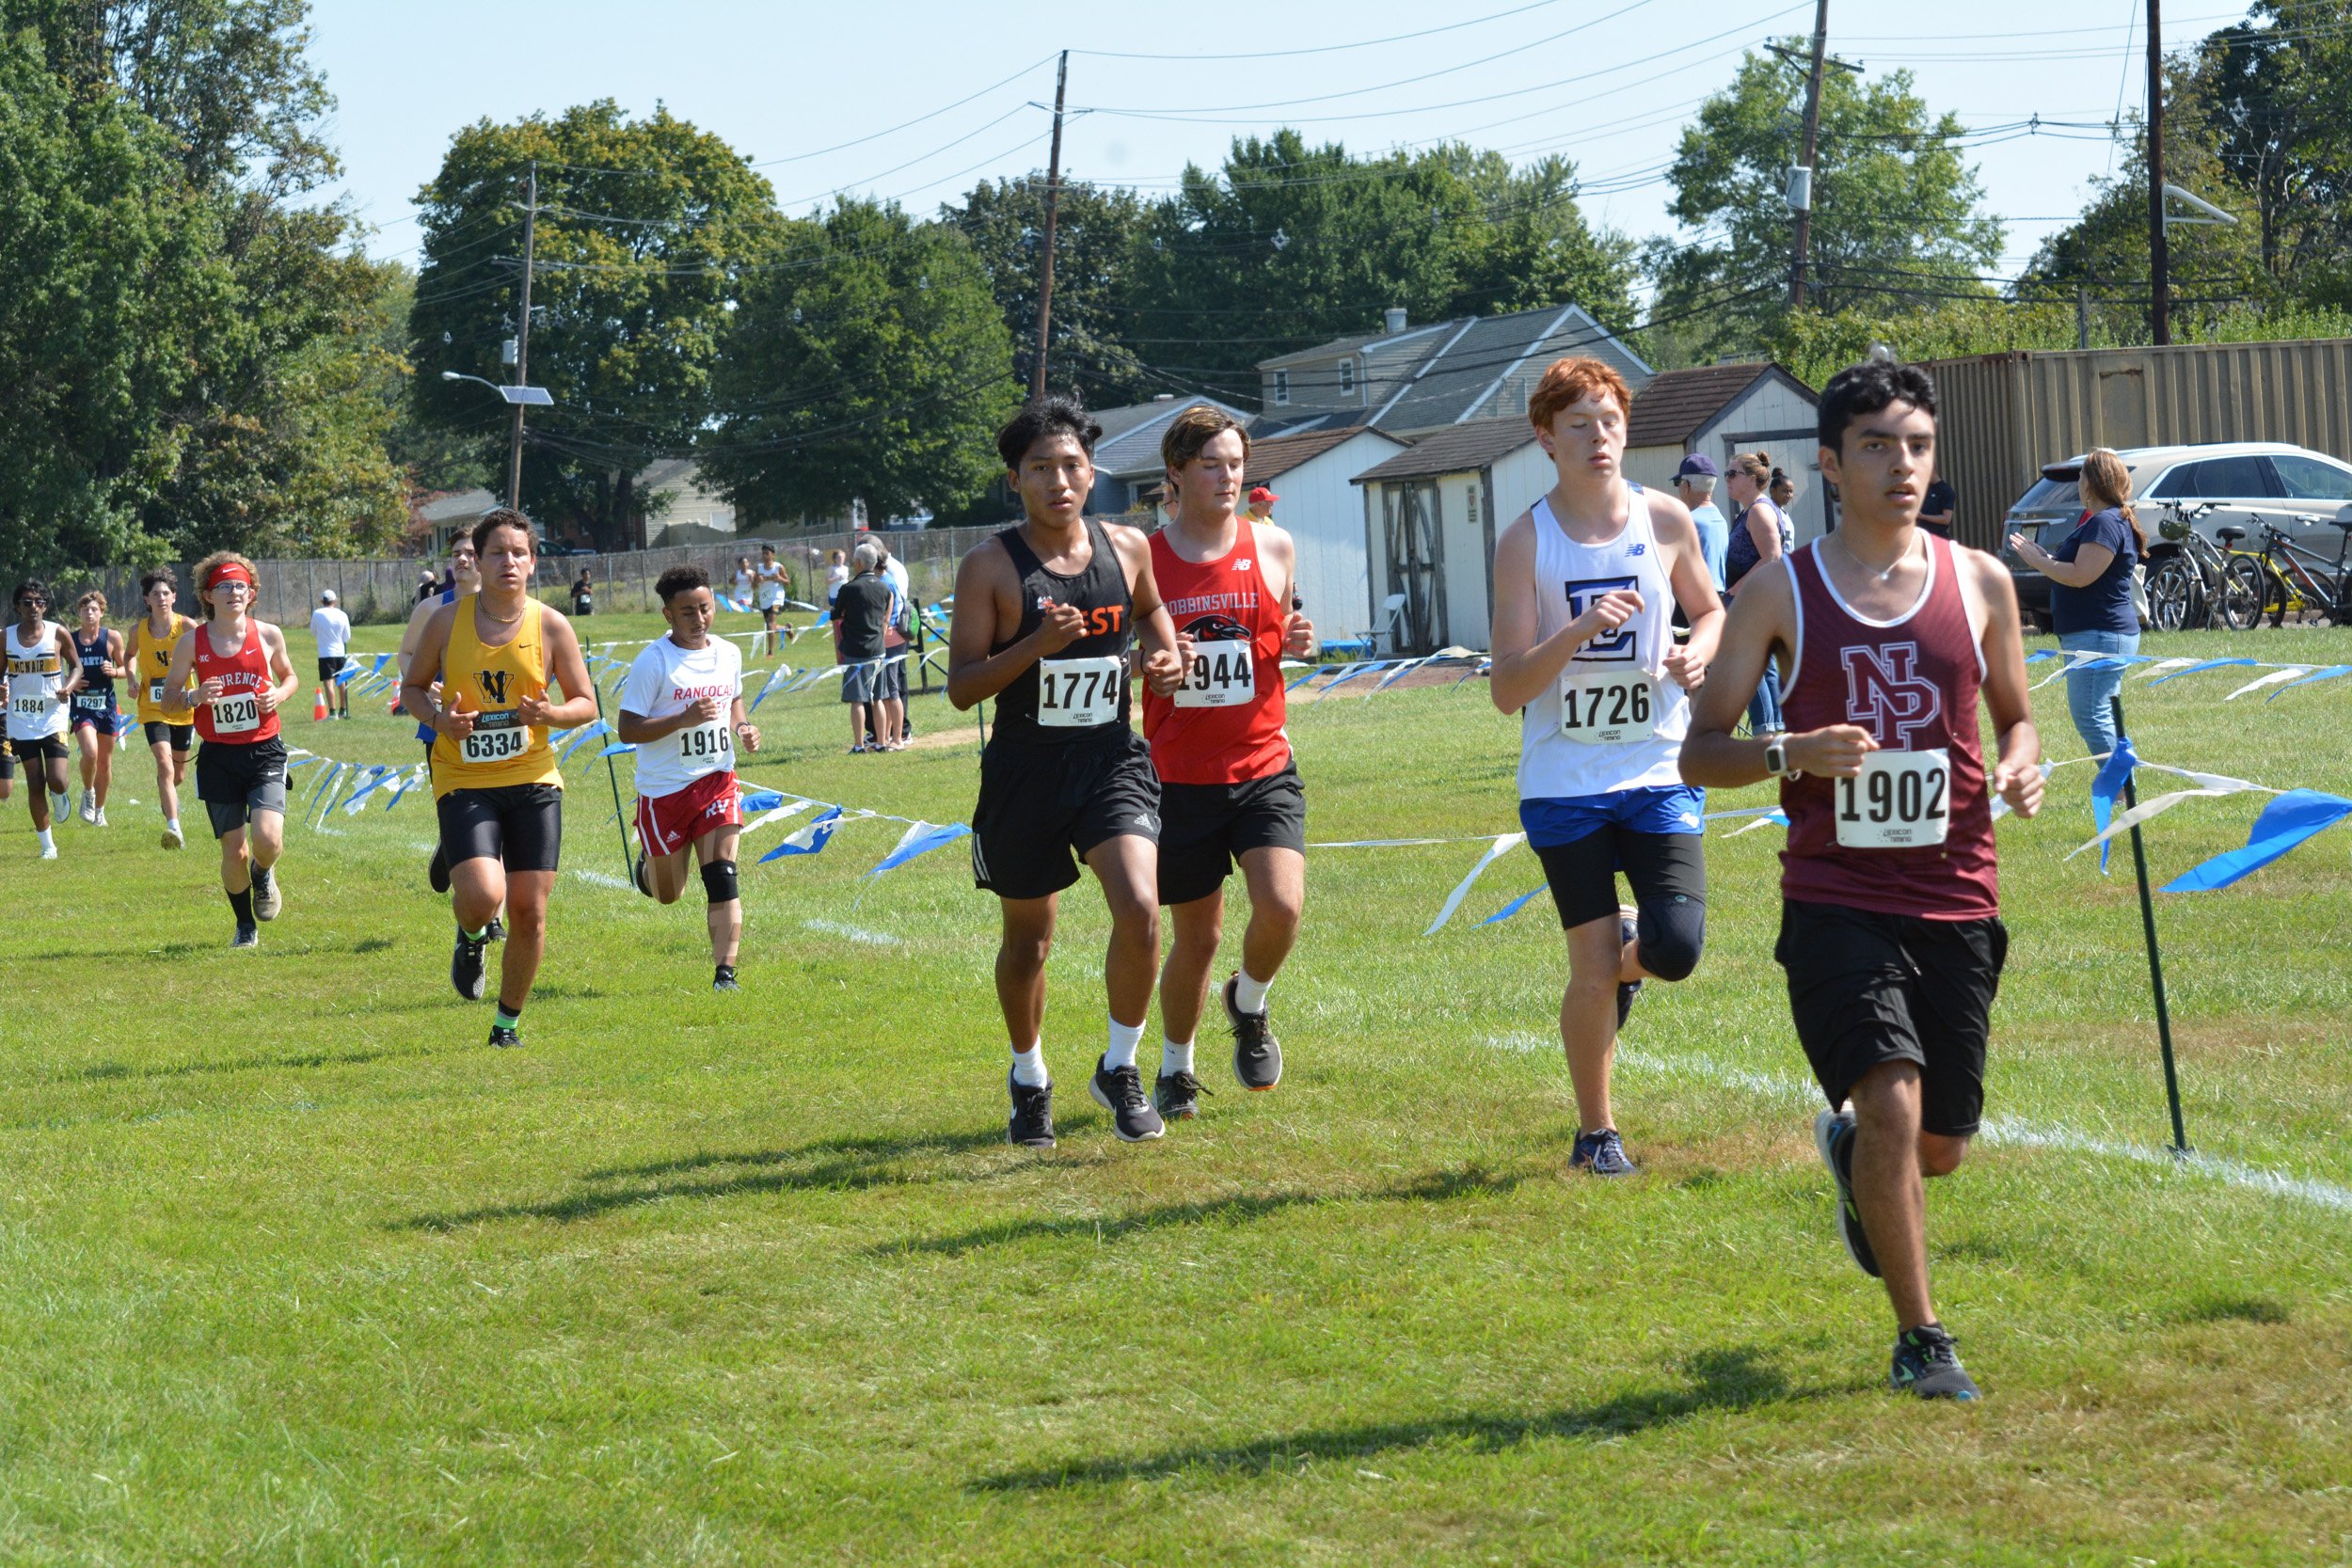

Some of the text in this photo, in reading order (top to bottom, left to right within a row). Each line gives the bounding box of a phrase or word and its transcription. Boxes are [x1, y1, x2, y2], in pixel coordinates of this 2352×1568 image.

[13, 659, 45, 673] MCNAIR
[217, 672, 263, 689] WRENCE
[1042, 670, 1117, 709] 1774
[81, 698, 103, 708] 6297
[673, 685, 734, 701] RANCOCAS
[14, 699, 45, 714] 1884
[213, 699, 257, 724] 1820
[1565, 683, 1649, 729] 1726
[467, 731, 523, 758] 6334
[681, 726, 729, 756] 1916
[1840, 768, 1946, 822] 1902
[707, 799, 729, 818] RV
